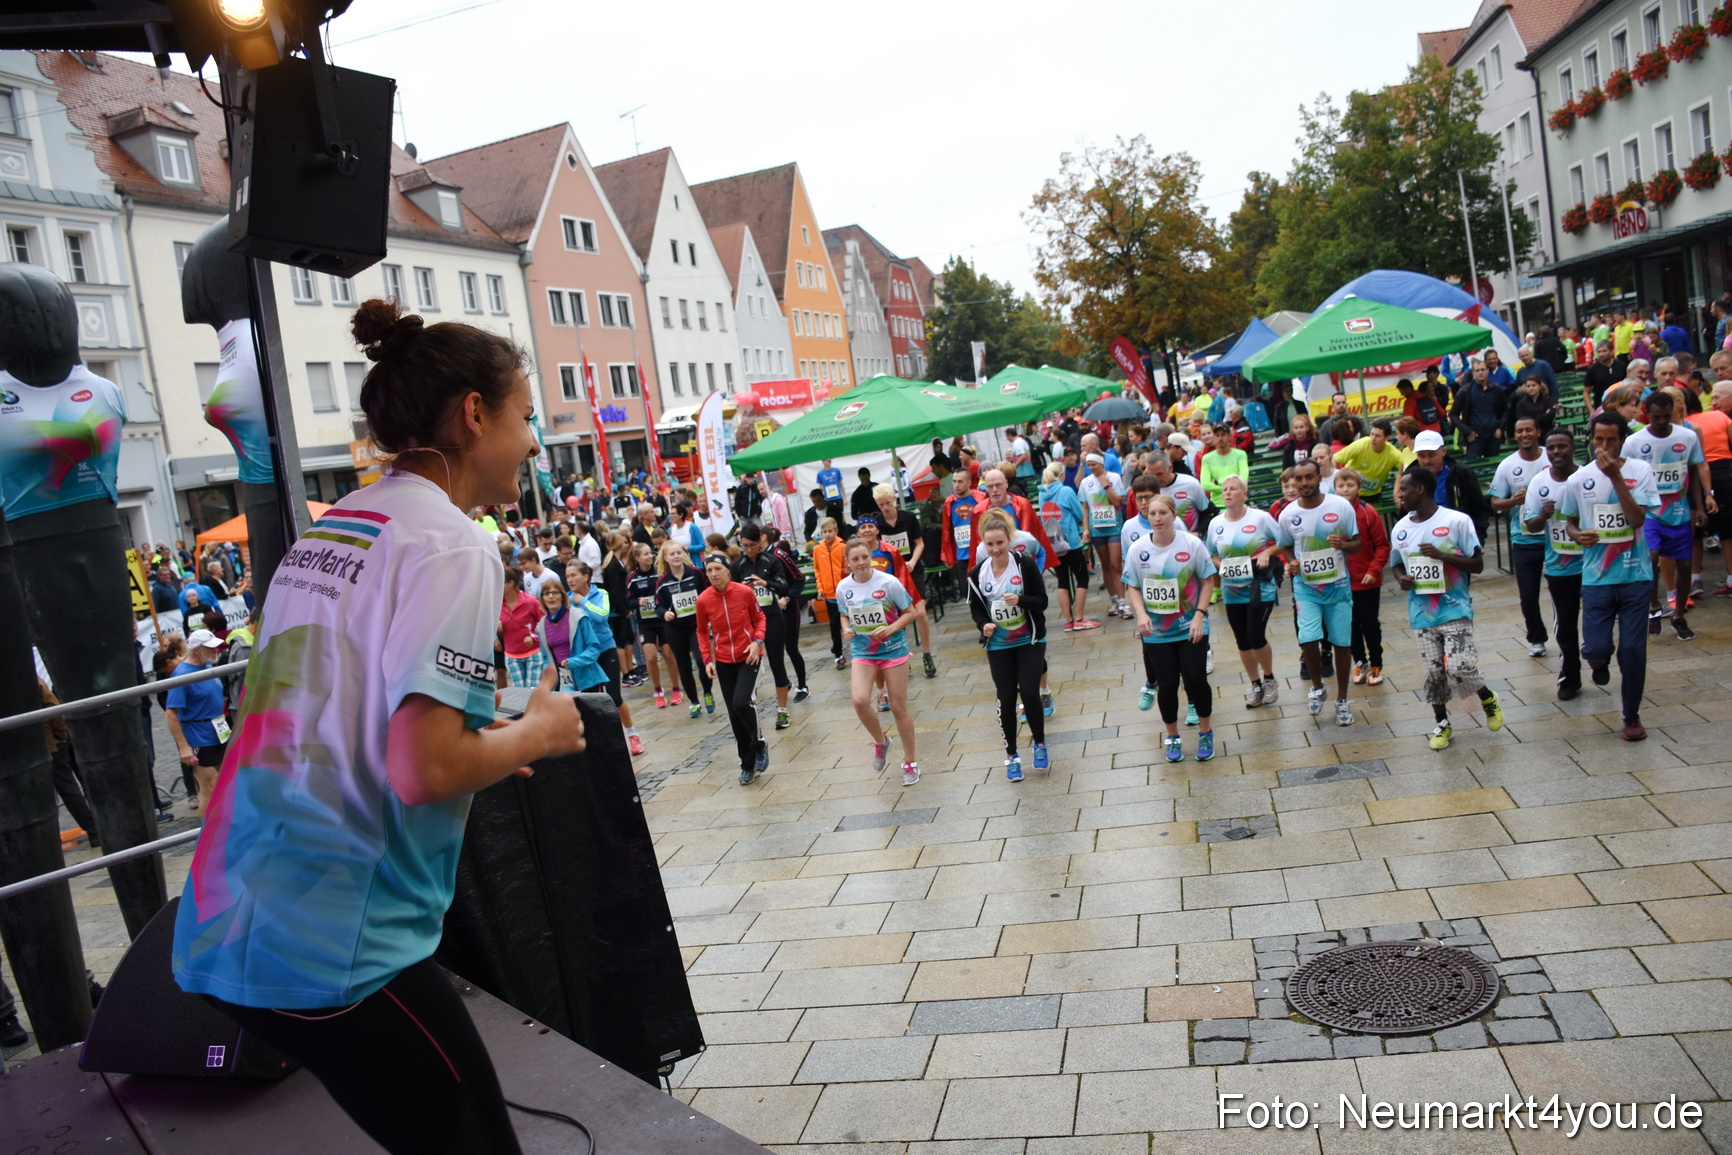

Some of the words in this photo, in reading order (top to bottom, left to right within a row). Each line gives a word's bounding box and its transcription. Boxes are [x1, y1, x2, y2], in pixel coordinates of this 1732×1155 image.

[1609, 208, 1647, 240] RENO
[1318, 332, 1415, 353] Lammsbräu
[1330, 330, 1399, 344] Neumarkter
[704, 421, 720, 494] KLEBL
[1598, 513, 1631, 528] 525
[884, 538, 906, 549] 277
[1222, 564, 1249, 578] 2664
[1303, 557, 1334, 573] 5239
[1410, 566, 1440, 580] 5238
[1146, 588, 1176, 600] 5034
[676, 596, 697, 609] 5049
[853, 612, 883, 625] 5142
